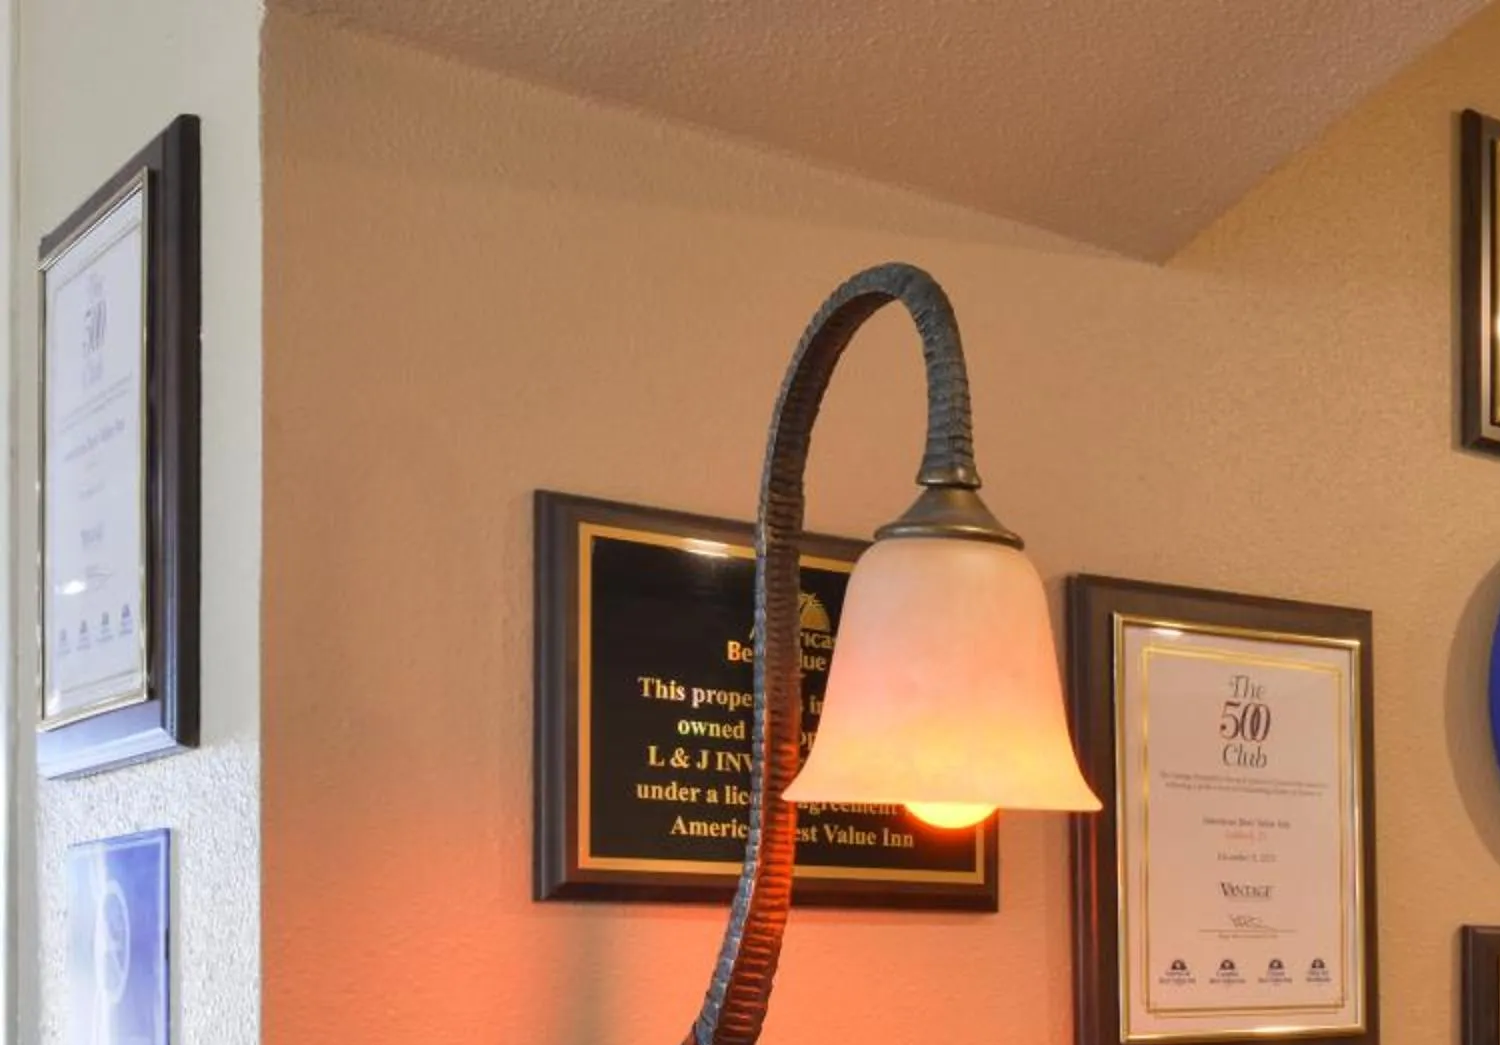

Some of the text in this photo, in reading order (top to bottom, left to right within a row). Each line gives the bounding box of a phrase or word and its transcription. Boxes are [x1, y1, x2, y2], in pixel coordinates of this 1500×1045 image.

[637, 677, 753, 711] This prope
[1229, 675, 1266, 700] The
[677, 718, 746, 740] owned
[648, 746, 665, 767] L
[670, 747, 690, 769] &
[696, 749, 709, 771] J
[1223, 743, 1267, 769] Club
[636, 781, 700, 803] under
[706, 786, 719, 804] a
[669, 815, 914, 848] Americ est Value Inn
